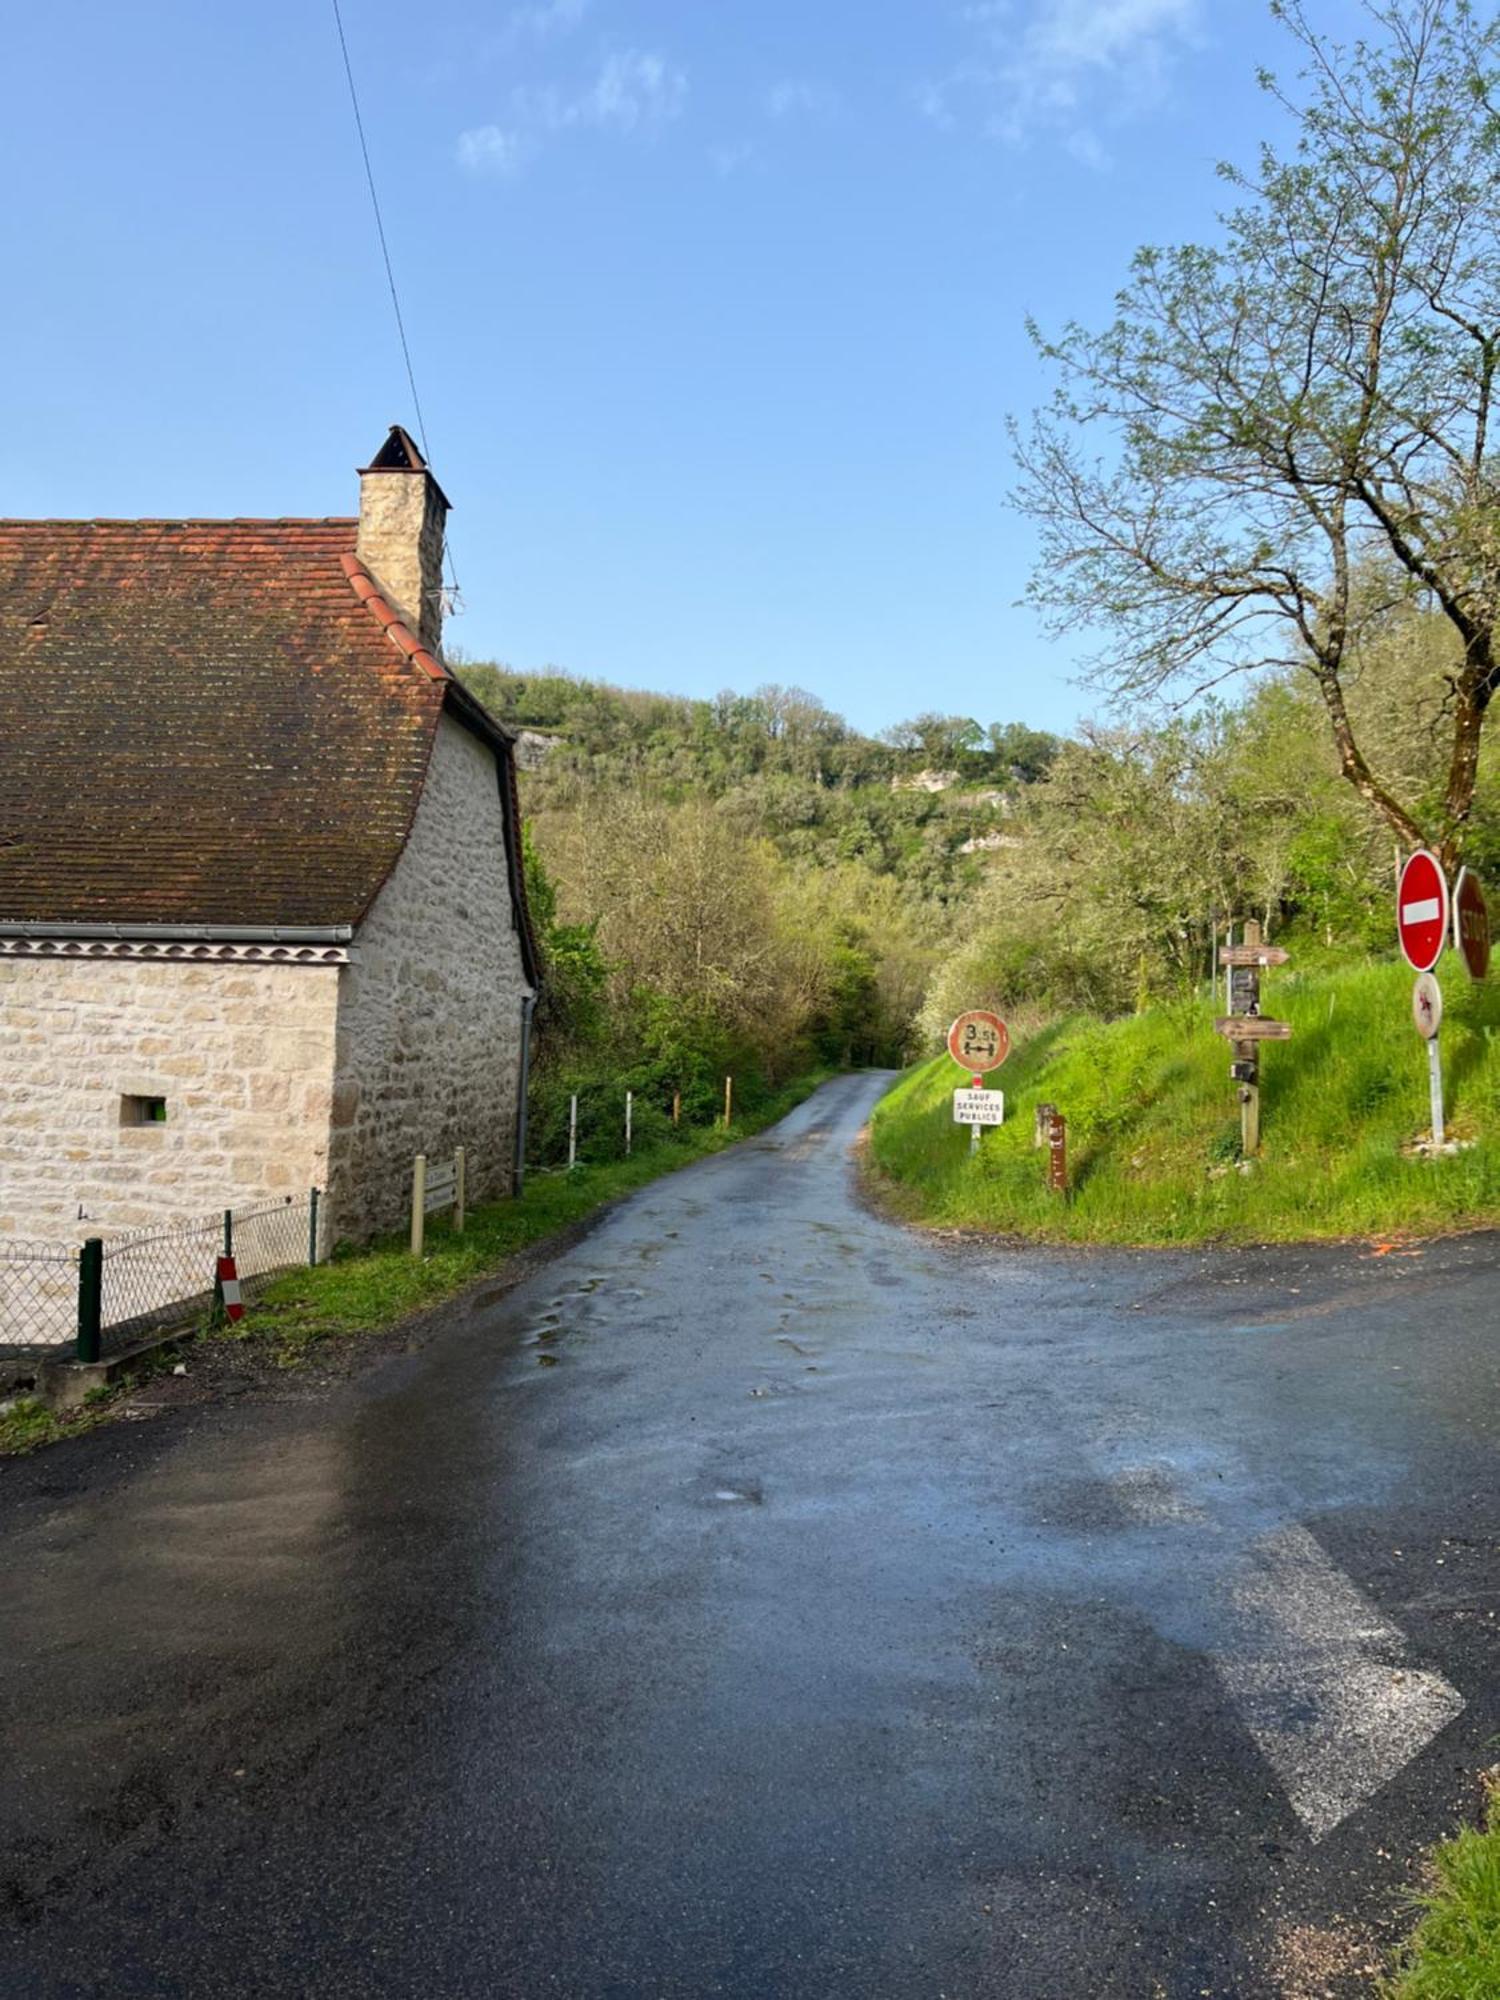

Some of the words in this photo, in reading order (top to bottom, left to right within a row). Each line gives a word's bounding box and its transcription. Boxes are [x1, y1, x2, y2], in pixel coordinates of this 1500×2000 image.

[1462, 910, 1488, 942] STOP
[967, 1092, 990, 1101] SAUF
[956, 1102, 1000, 1112] SERVICES
[959, 1112, 997, 1122] PUBLICS
